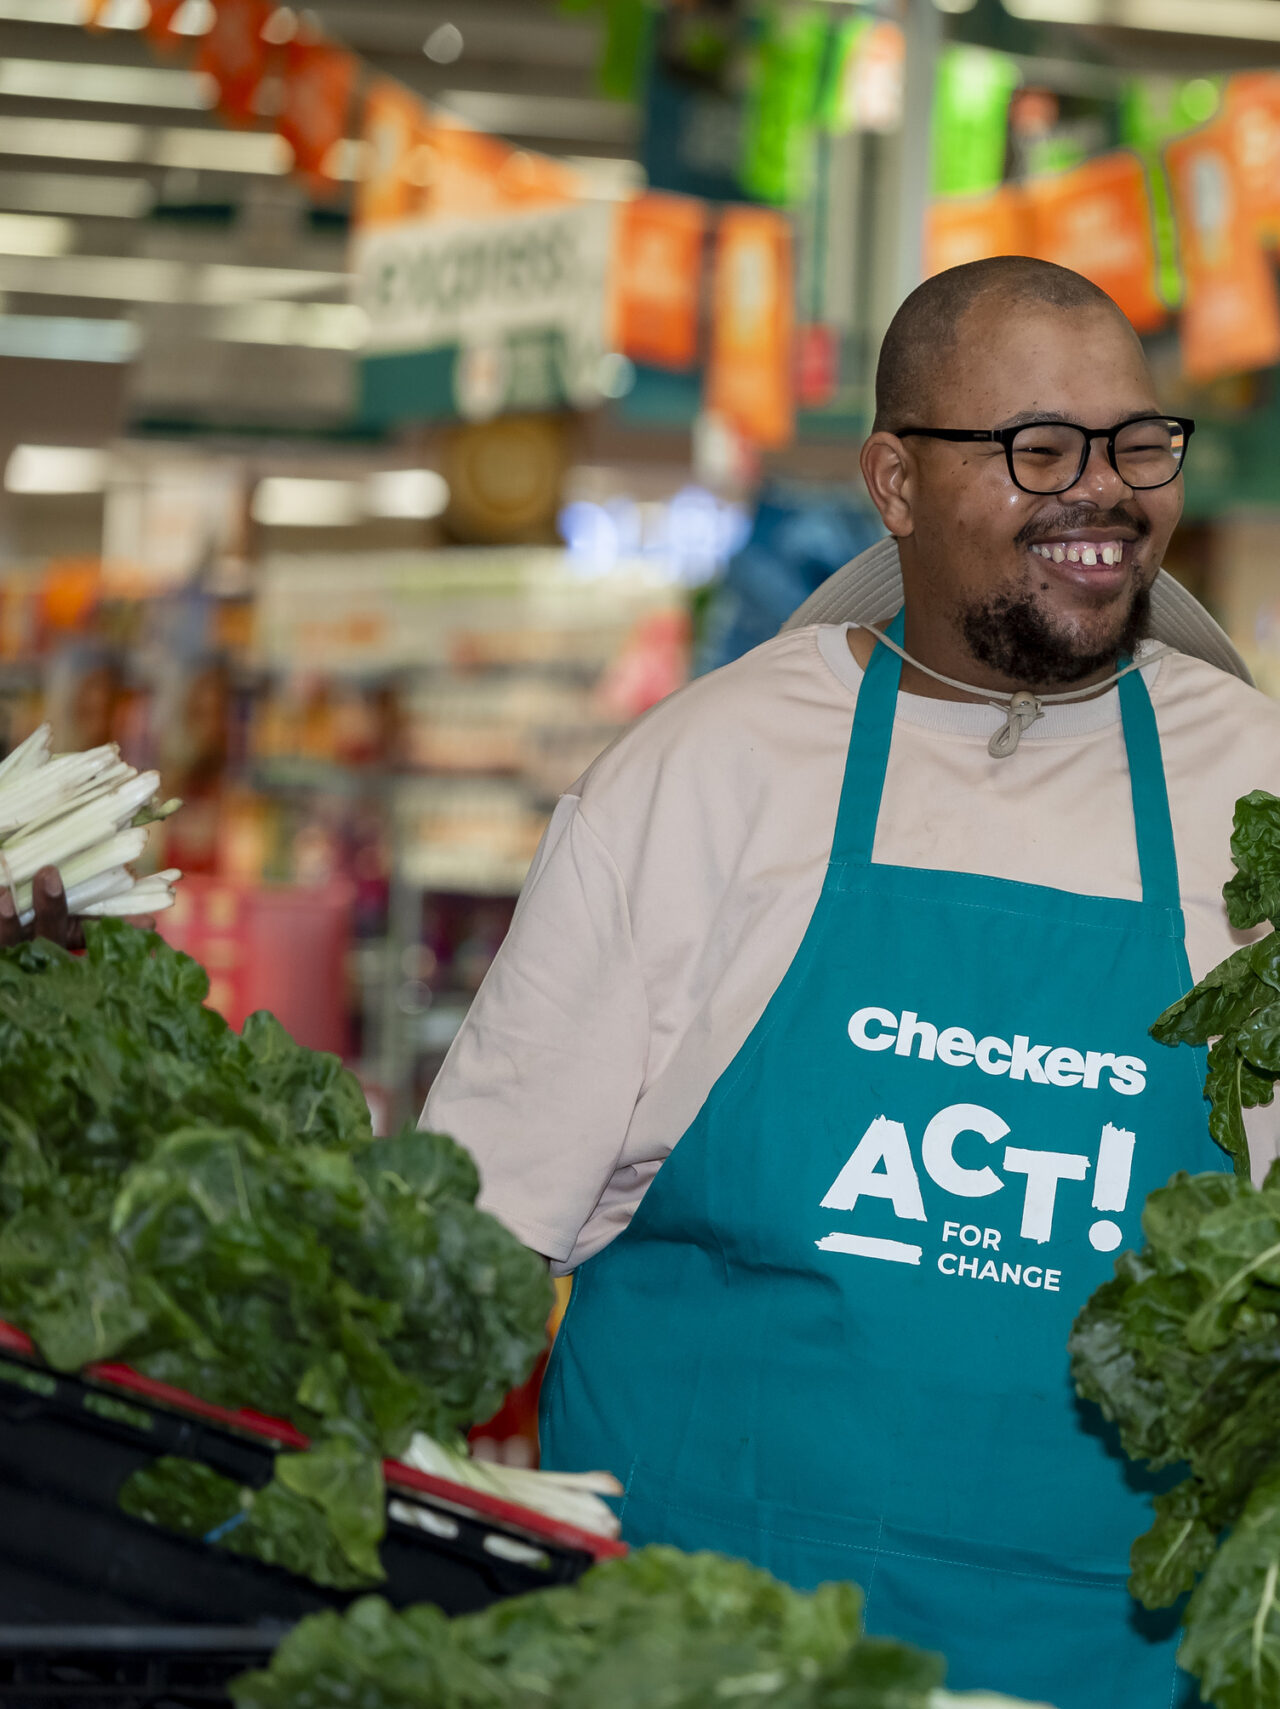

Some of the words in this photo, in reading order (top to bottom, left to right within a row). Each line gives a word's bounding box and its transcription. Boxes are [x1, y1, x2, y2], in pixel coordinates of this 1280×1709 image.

[819, 1103, 1136, 1252] ACT!
[941, 1221, 1002, 1251] FOR
[937, 1253, 1062, 1292] CHANGE
